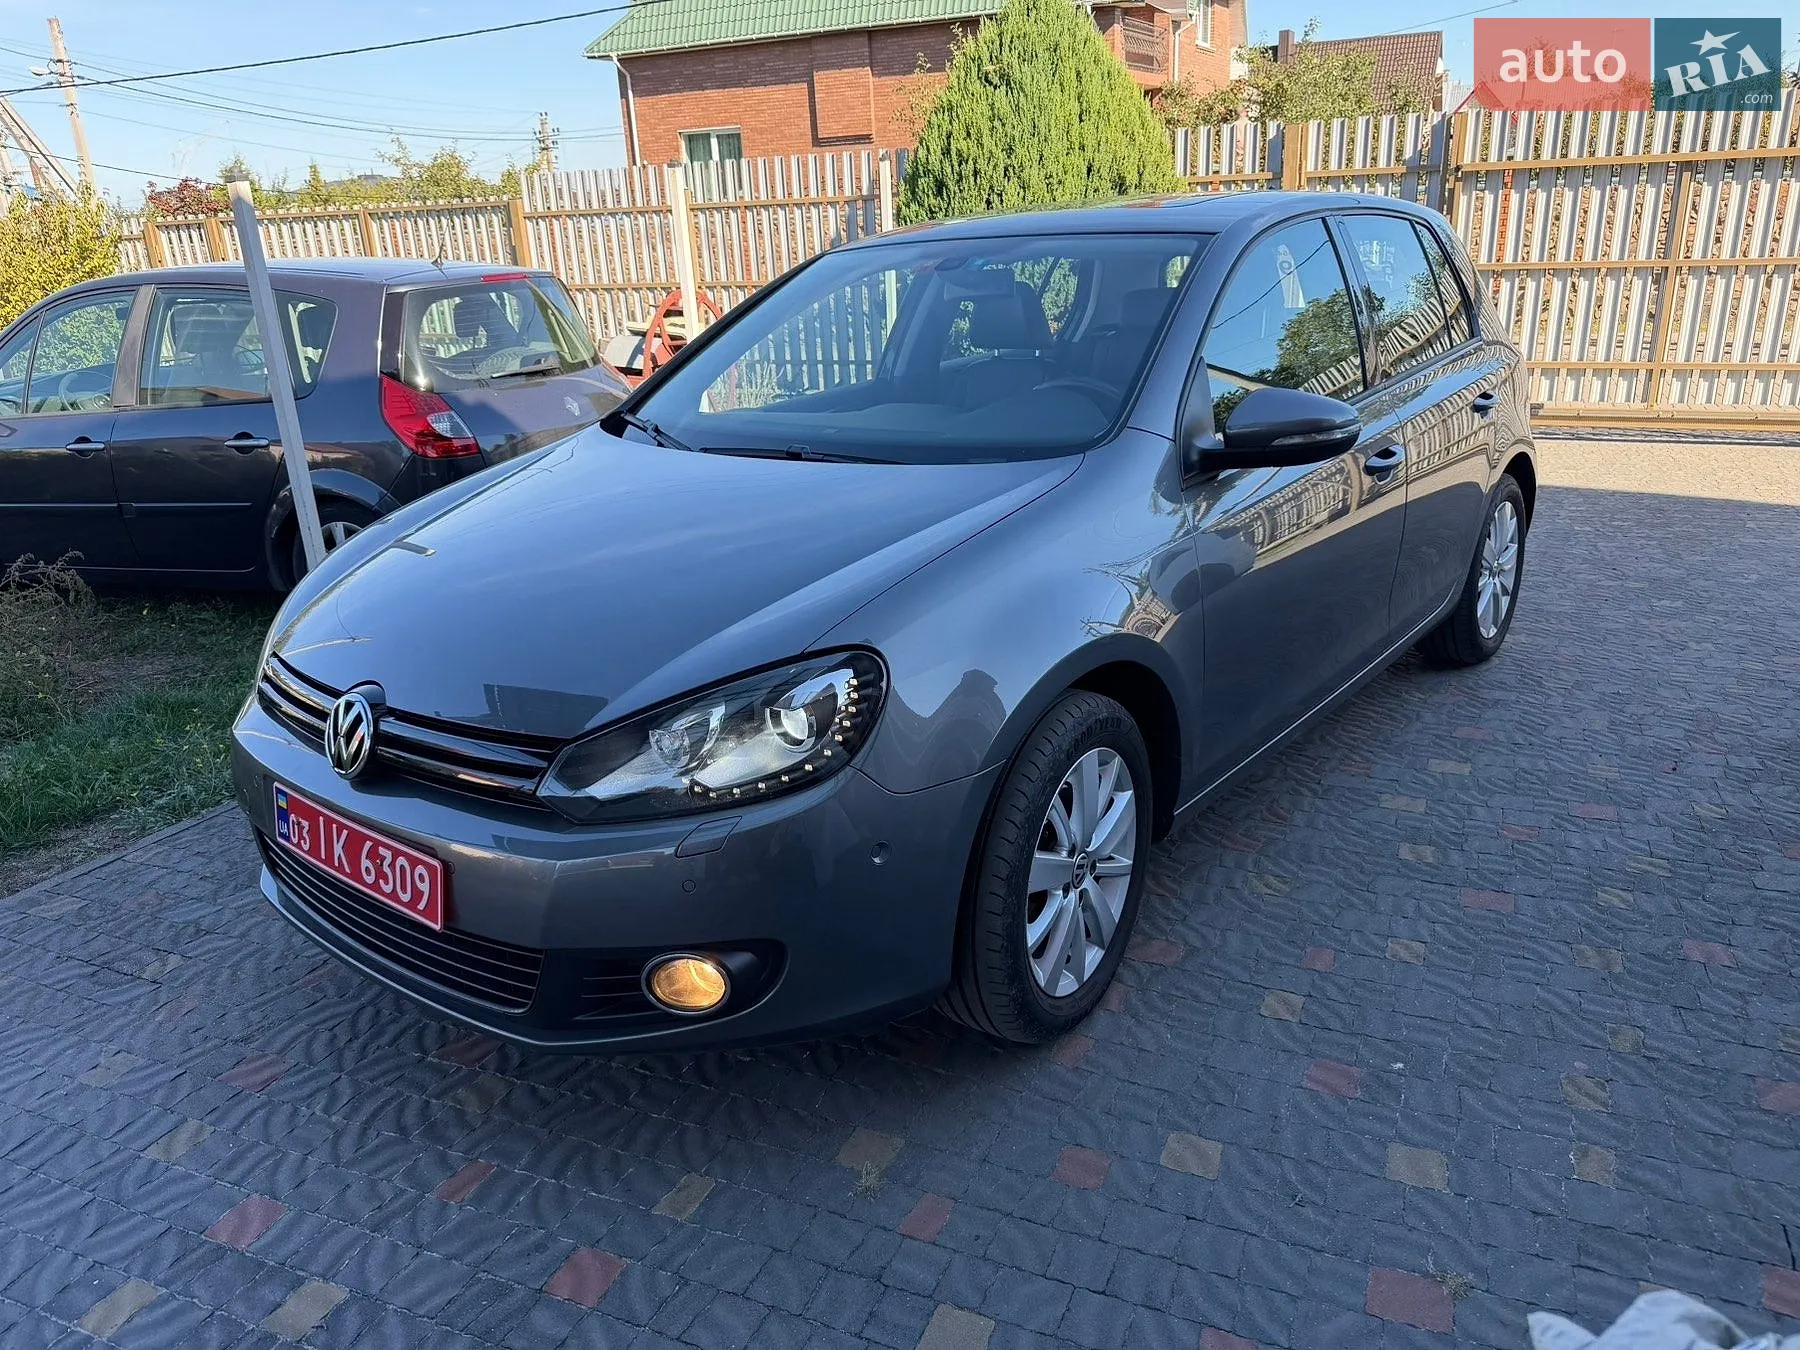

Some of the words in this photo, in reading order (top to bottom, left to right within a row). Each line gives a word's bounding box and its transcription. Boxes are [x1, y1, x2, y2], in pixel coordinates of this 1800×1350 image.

[278, 819, 289, 837] UA
[289, 813, 310, 850] 03
[319, 816, 350, 873] IK
[360, 841, 430, 911] 6309
